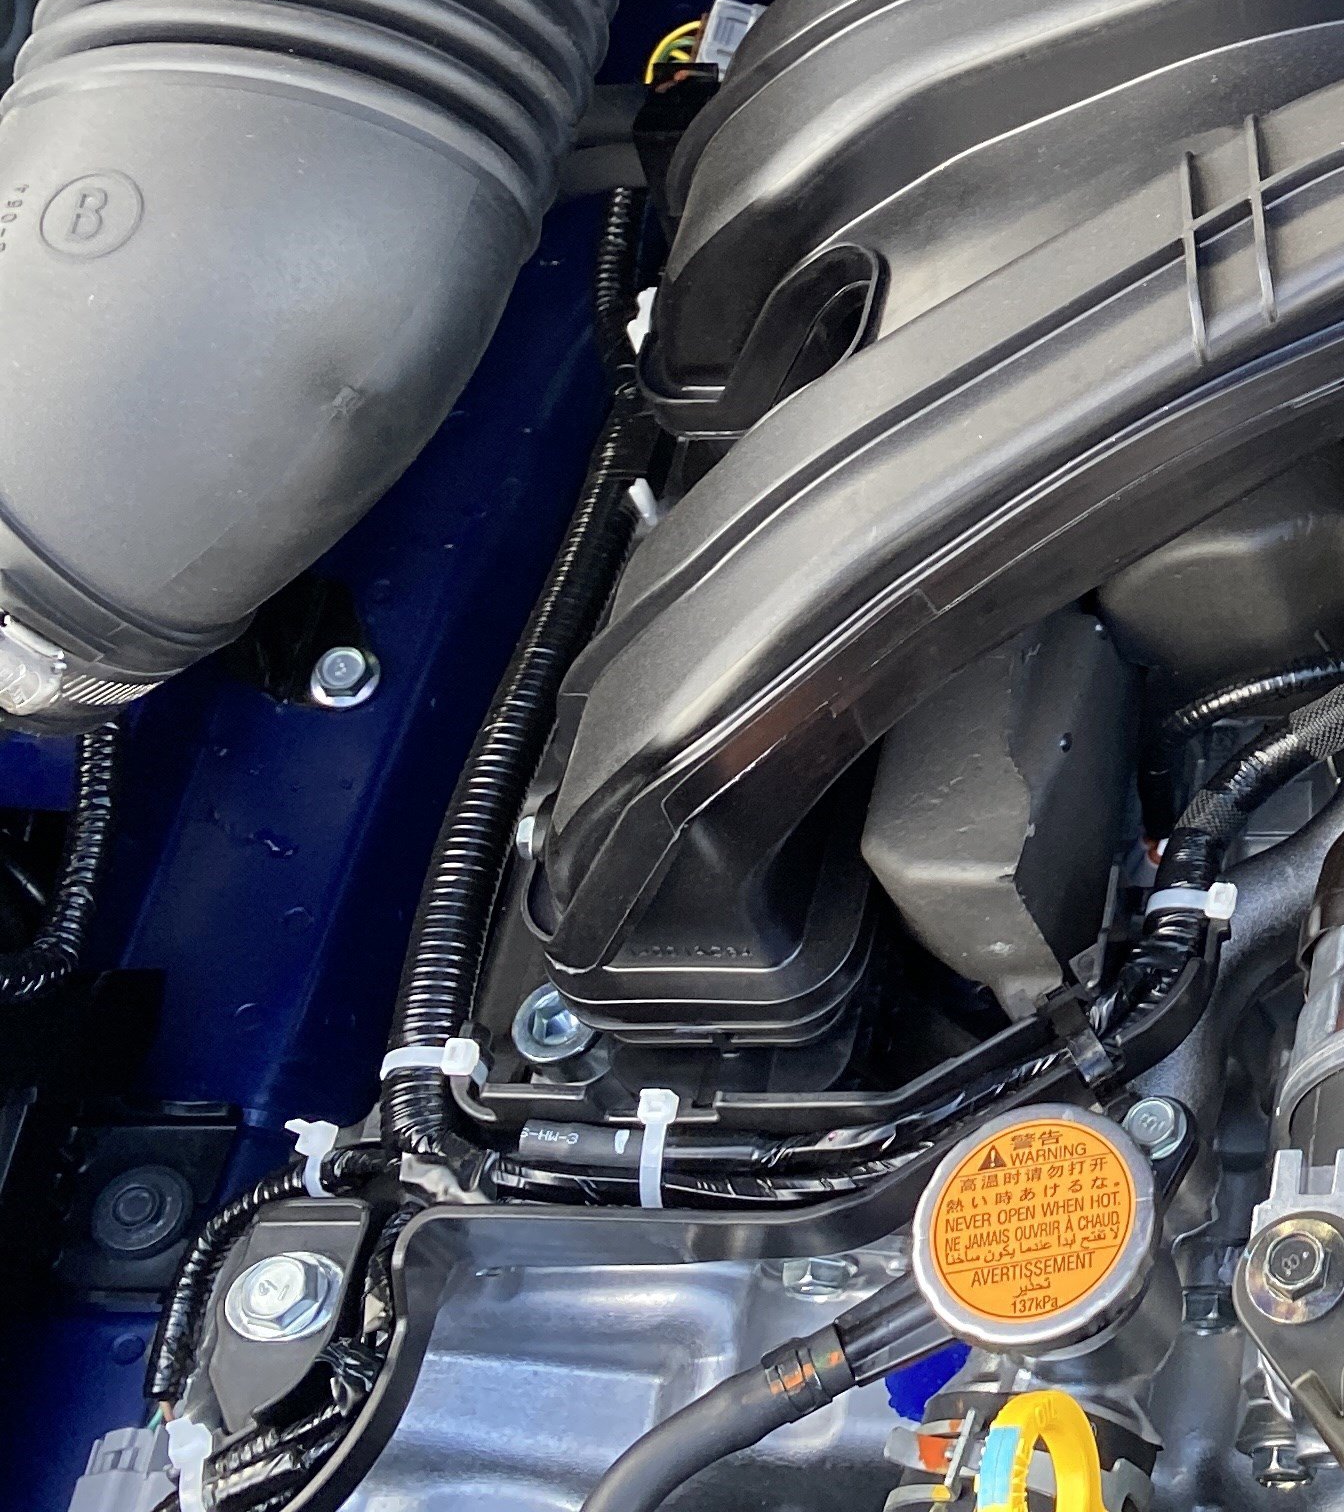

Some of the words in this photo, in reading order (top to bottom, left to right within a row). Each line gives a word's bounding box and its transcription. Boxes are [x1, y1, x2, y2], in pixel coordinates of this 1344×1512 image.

[66, 186, 108, 242] B
[1010, 1129, 1064, 1151] 警告
[1010, 1143, 1087, 1166] WARNING
[959, 1158, 1108, 1194] 高温时请勿打开
[944, 1212, 991, 1234] NEVER
[998, 1206, 1036, 1224] OPEN
[1042, 1198, 1084, 1218] WHEN
[1090, 1191, 1121, 1210] HOT.
[944, 1234, 961, 1253] NE
[964, 1228, 1010, 1250] JAMAIS
[1016, 1222, 1060, 1242] OUVRIR
[1066, 1215, 1074, 1234] À
[971, 1252, 1096, 1287] AVERTISSEMENT
[1011, 1296, 1059, 1314] 137kPa
